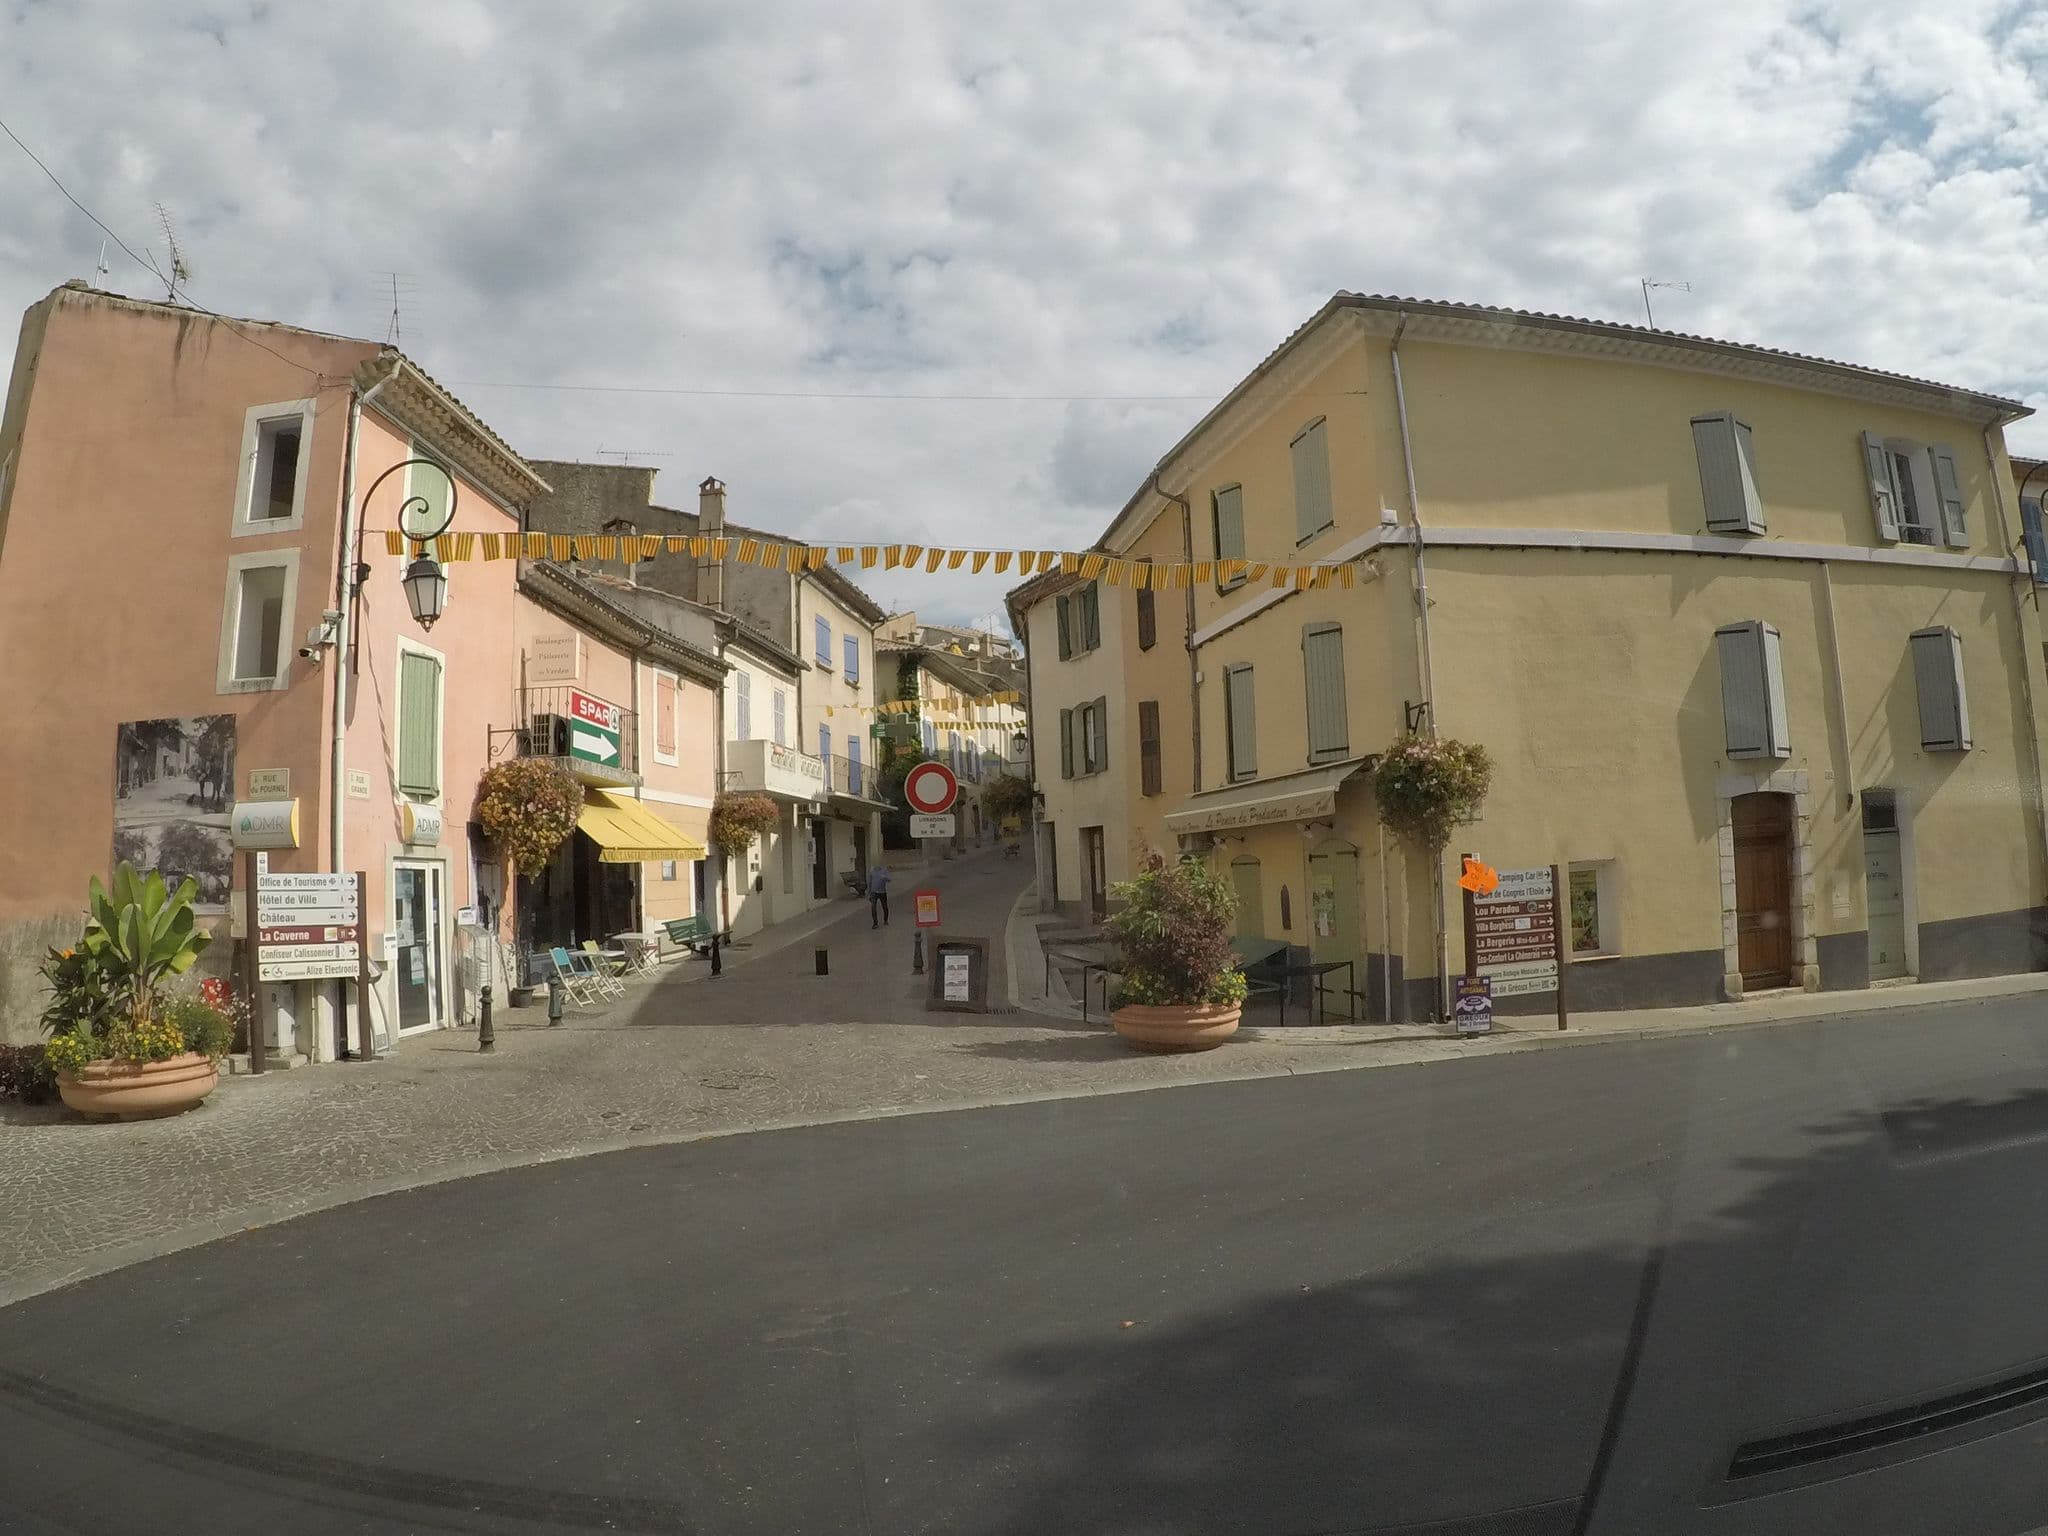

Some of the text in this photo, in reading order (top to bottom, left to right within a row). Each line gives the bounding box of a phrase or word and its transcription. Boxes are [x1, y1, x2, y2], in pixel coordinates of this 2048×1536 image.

[579, 699, 609, 723] SPAR
[262, 774, 278, 782] RUE
[259, 784, 286, 793] FOURNIL
[241, 816, 284, 832] ADMR
[416, 818, 441, 834] ADMR
[260, 877, 327, 887] Office de Tourisme
[1498, 872, 1536, 883] Camping Car
[1494, 890, 1502, 898] de
[259, 894, 317, 905] Hôtel de Ville
[1475, 904, 1520, 916] Lou Paradou
[260, 913, 296, 923] Château
[1476, 923, 1489, 932] Villa
[260, 931, 310, 941] La Caverne
[1476, 940, 1485, 948] La
[1486, 937, 1515, 948] Bergerie
[260, 947, 334, 960] Confiseur Calissonnier
[1508, 952, 1515, 961] La
[324, 965, 358, 974] Electronic
